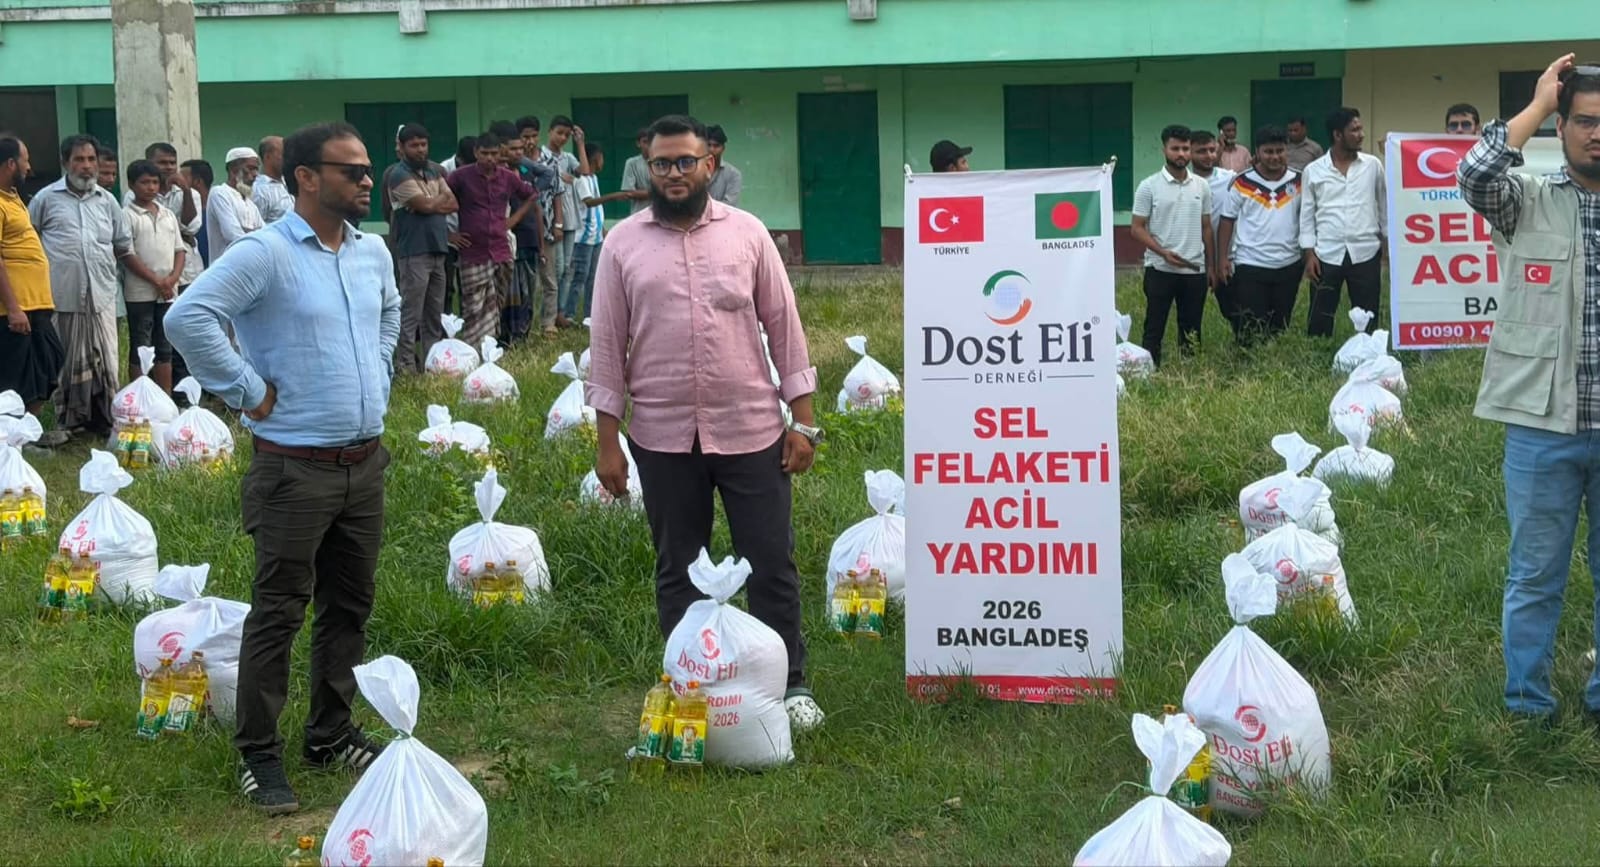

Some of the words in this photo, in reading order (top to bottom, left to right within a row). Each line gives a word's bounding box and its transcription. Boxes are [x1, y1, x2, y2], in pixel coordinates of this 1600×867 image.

[1404, 212, 1492, 244] SEL
[933, 246, 970, 255] TÜRKİYE
[1042, 240, 1095, 250] BANGLADEŞ
[1412, 245, 1499, 285] ACİ
[921, 326, 1024, 366] Dost
[974, 369, 1043, 384] DERNEĞİ
[973, 406, 1048, 439] SEL
[913, 442, 1110, 484] FELAKETİ
[964, 488, 1059, 529] ACİL
[926, 542, 1098, 575] YARDIMI
[982, 600, 1042, 619] 2026
[937, 627, 1089, 652] BANGLADEŞ
[677, 648, 711, 680] Dost
[717, 661, 739, 681] Eli
[707, 694, 743, 708] RDIMI
[713, 711, 740, 728] 2026
[1212, 732, 1263, 765] Dost
